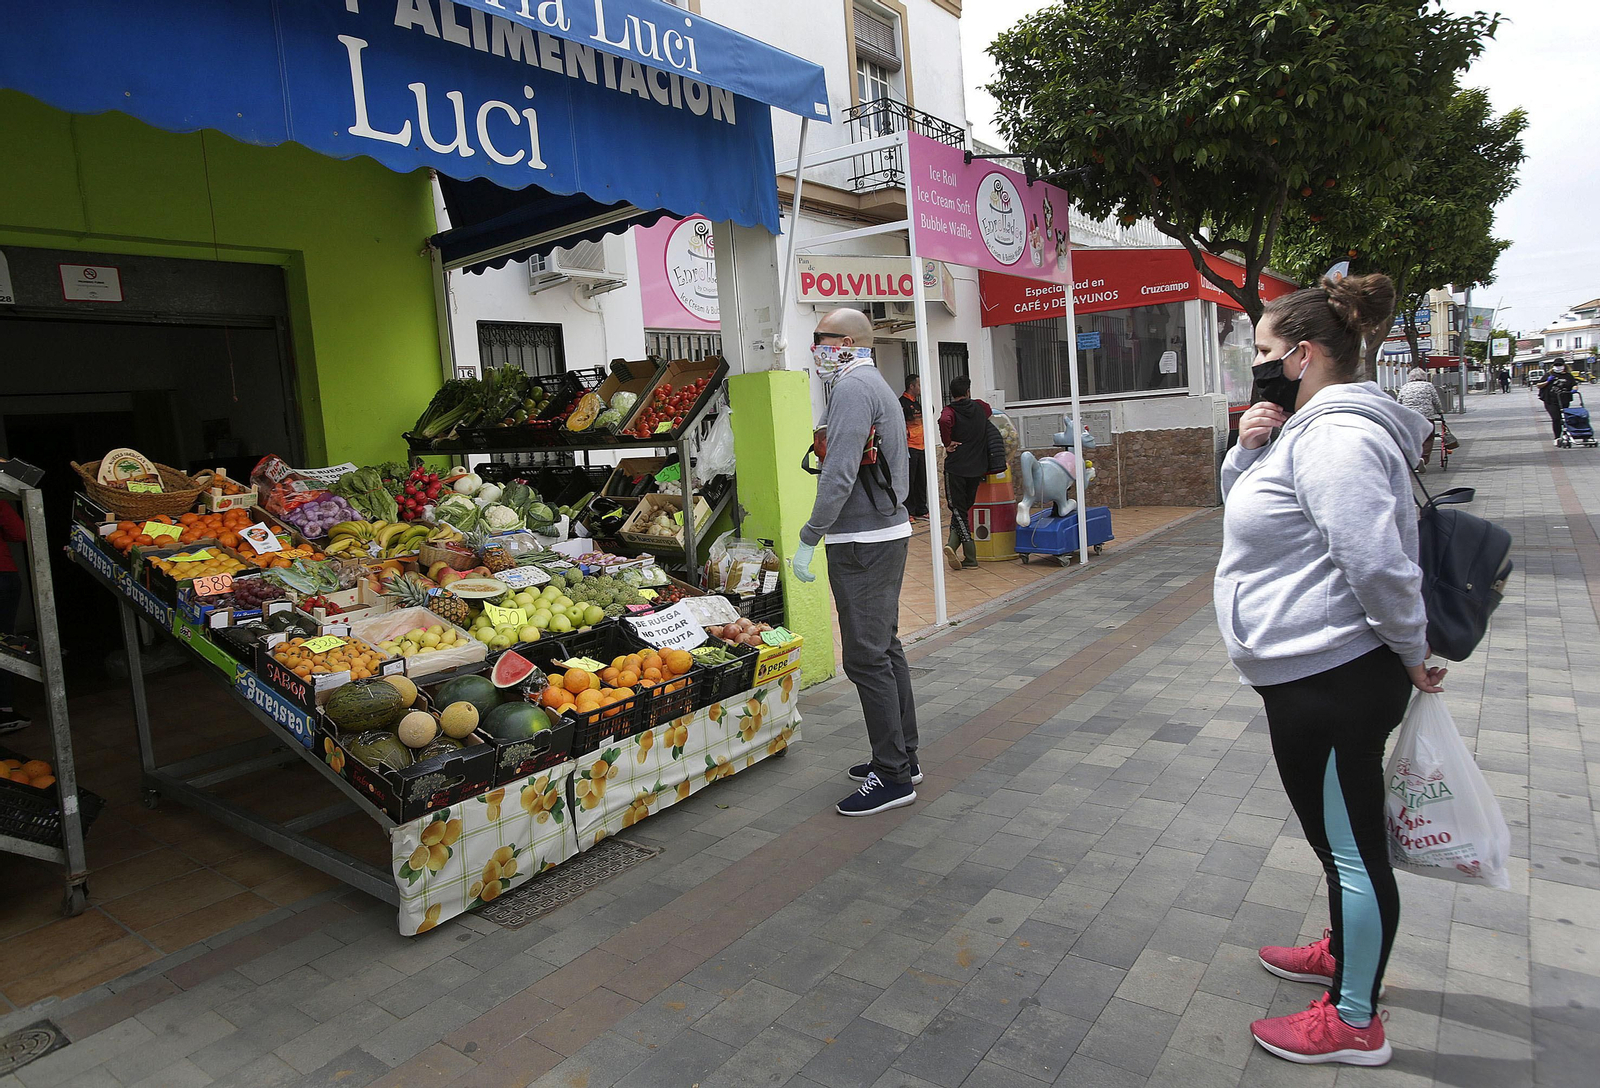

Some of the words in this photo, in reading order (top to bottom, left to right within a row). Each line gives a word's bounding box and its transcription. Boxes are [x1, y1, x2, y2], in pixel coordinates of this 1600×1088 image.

[589, 0, 702, 74] Luci
[337, 34, 547, 170] Luci
[929, 165, 941, 182] Ice
[942, 171, 957, 188] Roll
[917, 186, 930, 202] Ice
[930, 190, 956, 211] Cream
[956, 199, 971, 215] Soft
[920, 213, 948, 235] Bubble
[948, 221, 973, 240] Waffle
[801, 272, 914, 296] POLVILLO
[1091, 278, 1105, 288] en
[1141, 281, 1190, 296] Cruzcampo
[1014, 301, 1041, 314] CAFÉ
[1043, 302, 1050, 311] y
[1051, 290, 1119, 309] DEAYUNOS
[461, 369, 474, 378] 16
[196, 574, 233, 595] 3'80
[635, 620, 648, 628] SE
[648, 610, 681, 627] RUEGA
[641, 629, 655, 638] NO
[655, 619, 689, 636] TOCAR
[662, 630, 694, 648] FRUTA
[767, 659, 788, 675] pepe
[265, 663, 308, 706] SABOR
[246, 676, 304, 735] castang
